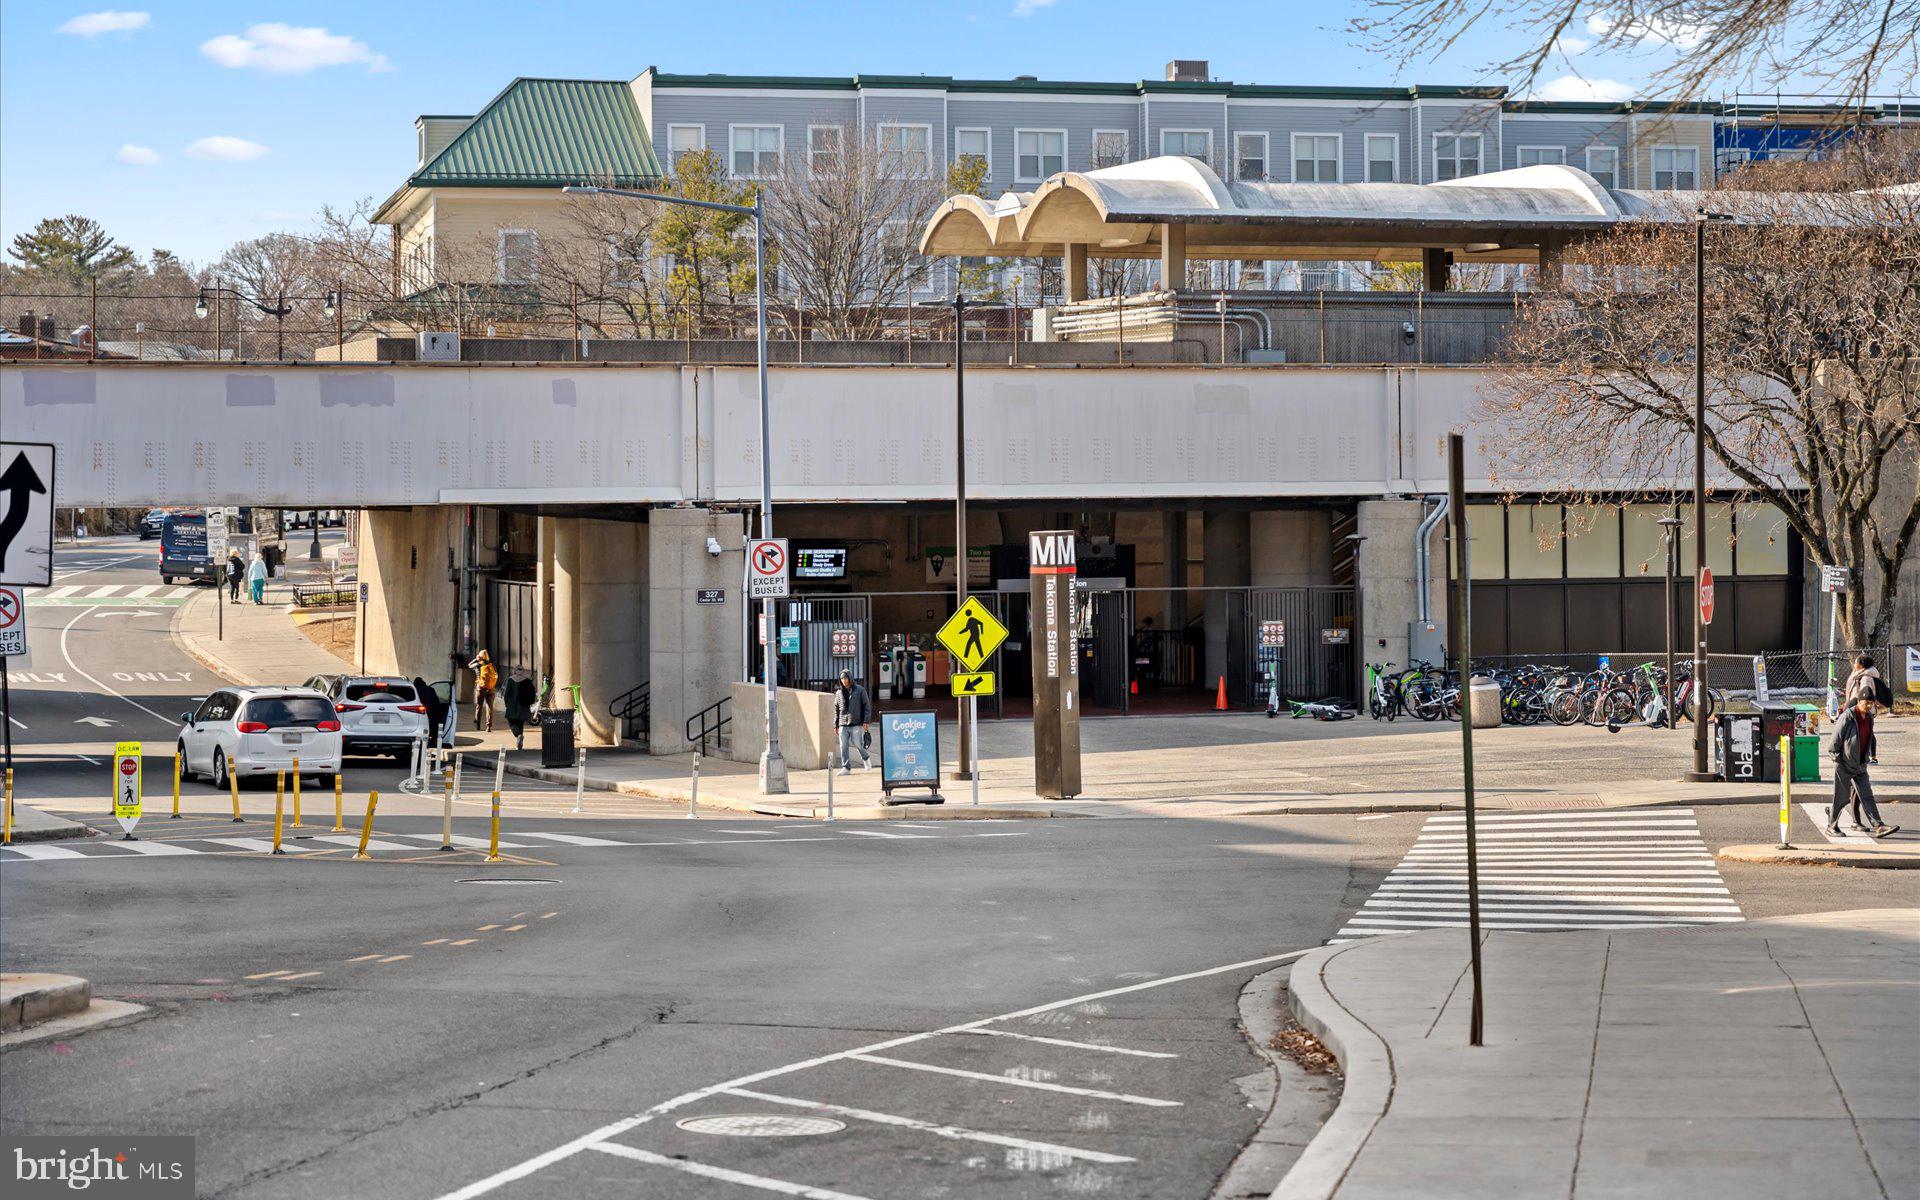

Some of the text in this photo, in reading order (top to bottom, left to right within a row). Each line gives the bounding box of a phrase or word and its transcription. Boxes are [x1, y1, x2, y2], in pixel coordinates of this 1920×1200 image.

[1032, 536, 1056, 565] M
[1057, 536, 1075, 564] M
[754, 577, 786, 586] EXCEPT
[754, 586, 784, 595] BUSES
[1702, 584, 1713, 607] STOP
[1046, 577, 1057, 676] Takoma Station
[1070, 630, 1078, 675] Station
[112, 672, 192, 682] ONLY
[892, 718, 926, 732] Cookies
[902, 729, 916, 739] DC
